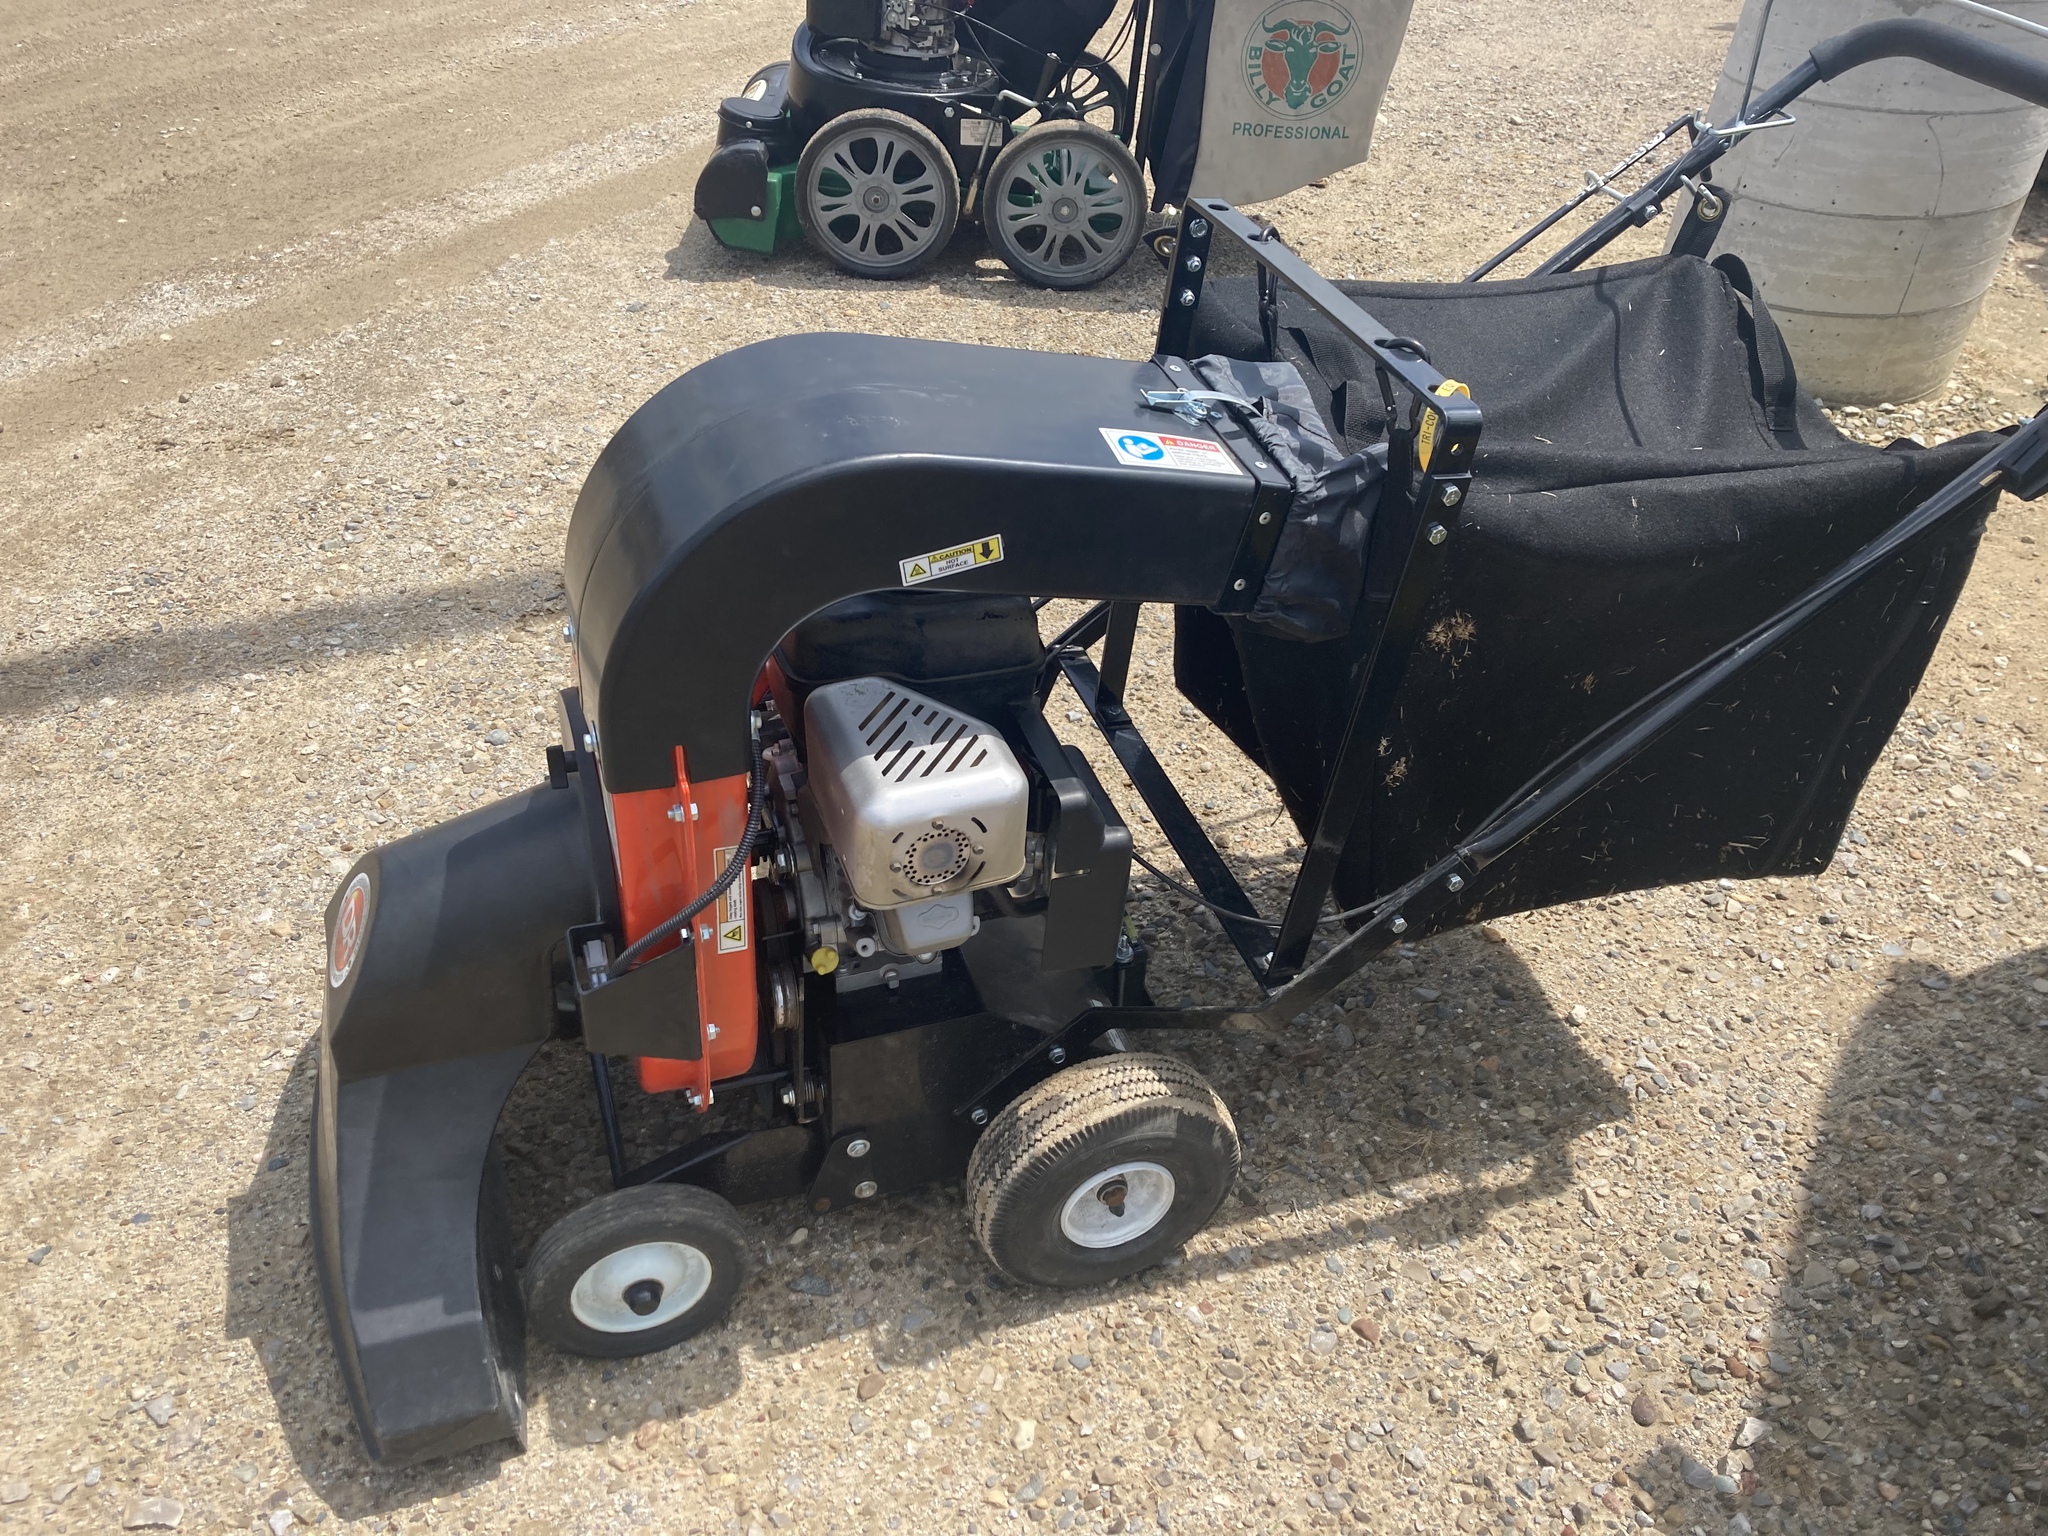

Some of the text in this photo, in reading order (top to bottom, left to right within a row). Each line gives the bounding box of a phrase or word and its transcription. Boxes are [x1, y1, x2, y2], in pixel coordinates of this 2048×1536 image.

[1248, 45, 1356, 109] BILLY GOAT
[1232, 121, 1350, 140] PROFESSIONAL
[1176, 439, 1217, 451] DANGER
[939, 547, 972, 560] CAUTION
[938, 560, 968, 572] SURFACE
[945, 557, 960, 566] HOT
